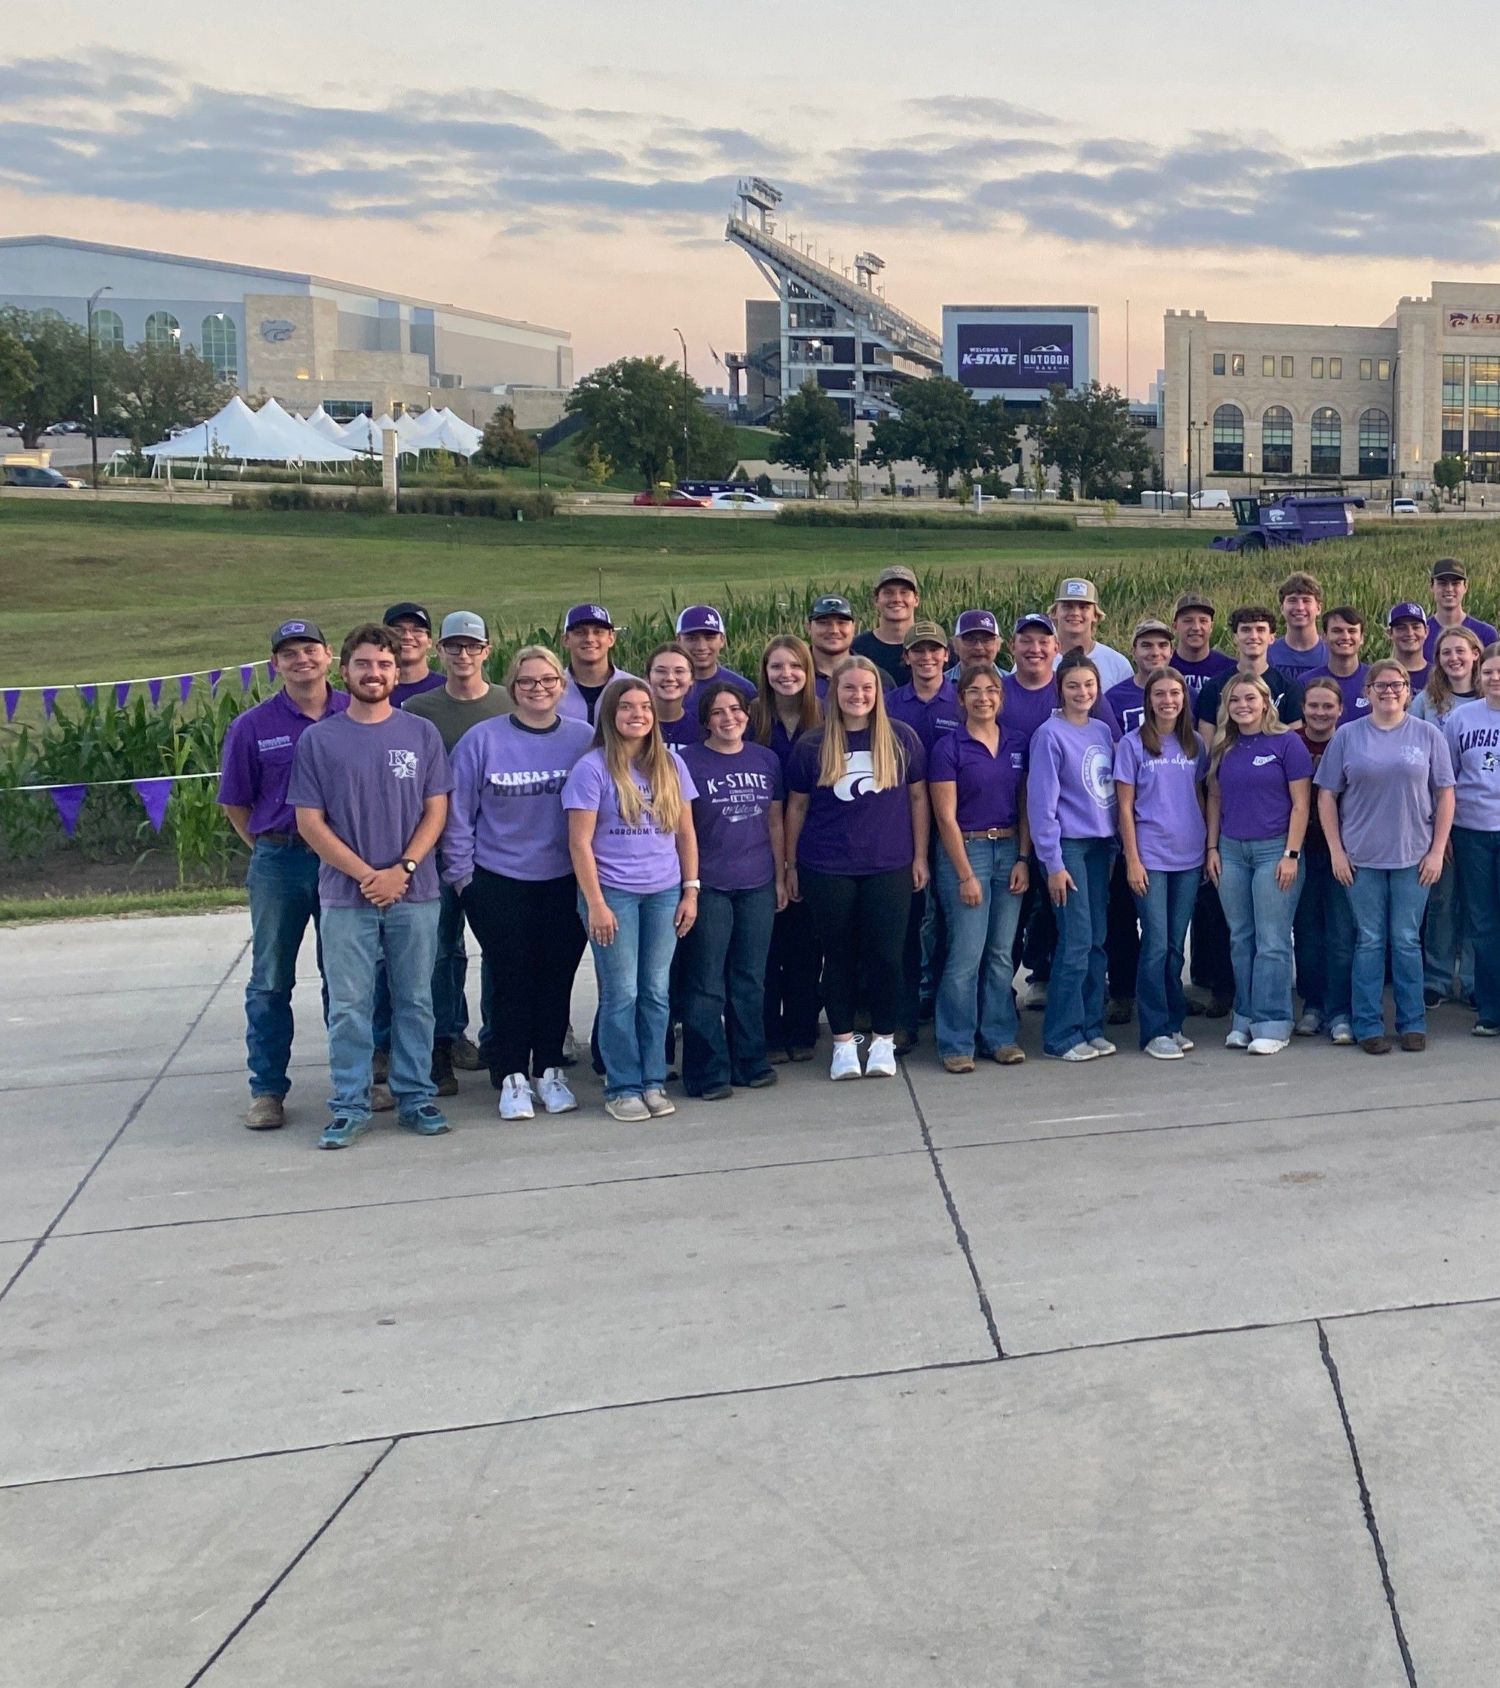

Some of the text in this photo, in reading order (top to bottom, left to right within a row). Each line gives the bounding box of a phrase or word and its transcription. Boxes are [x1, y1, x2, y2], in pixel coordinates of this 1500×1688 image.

[962, 353, 1018, 365] K-STATE
[1023, 354, 1069, 365] OUTDOOR
[1459, 728, 1500, 753] KANSAS
[490, 770, 550, 786] KANSAS
[707, 772, 768, 796] K-STATE
